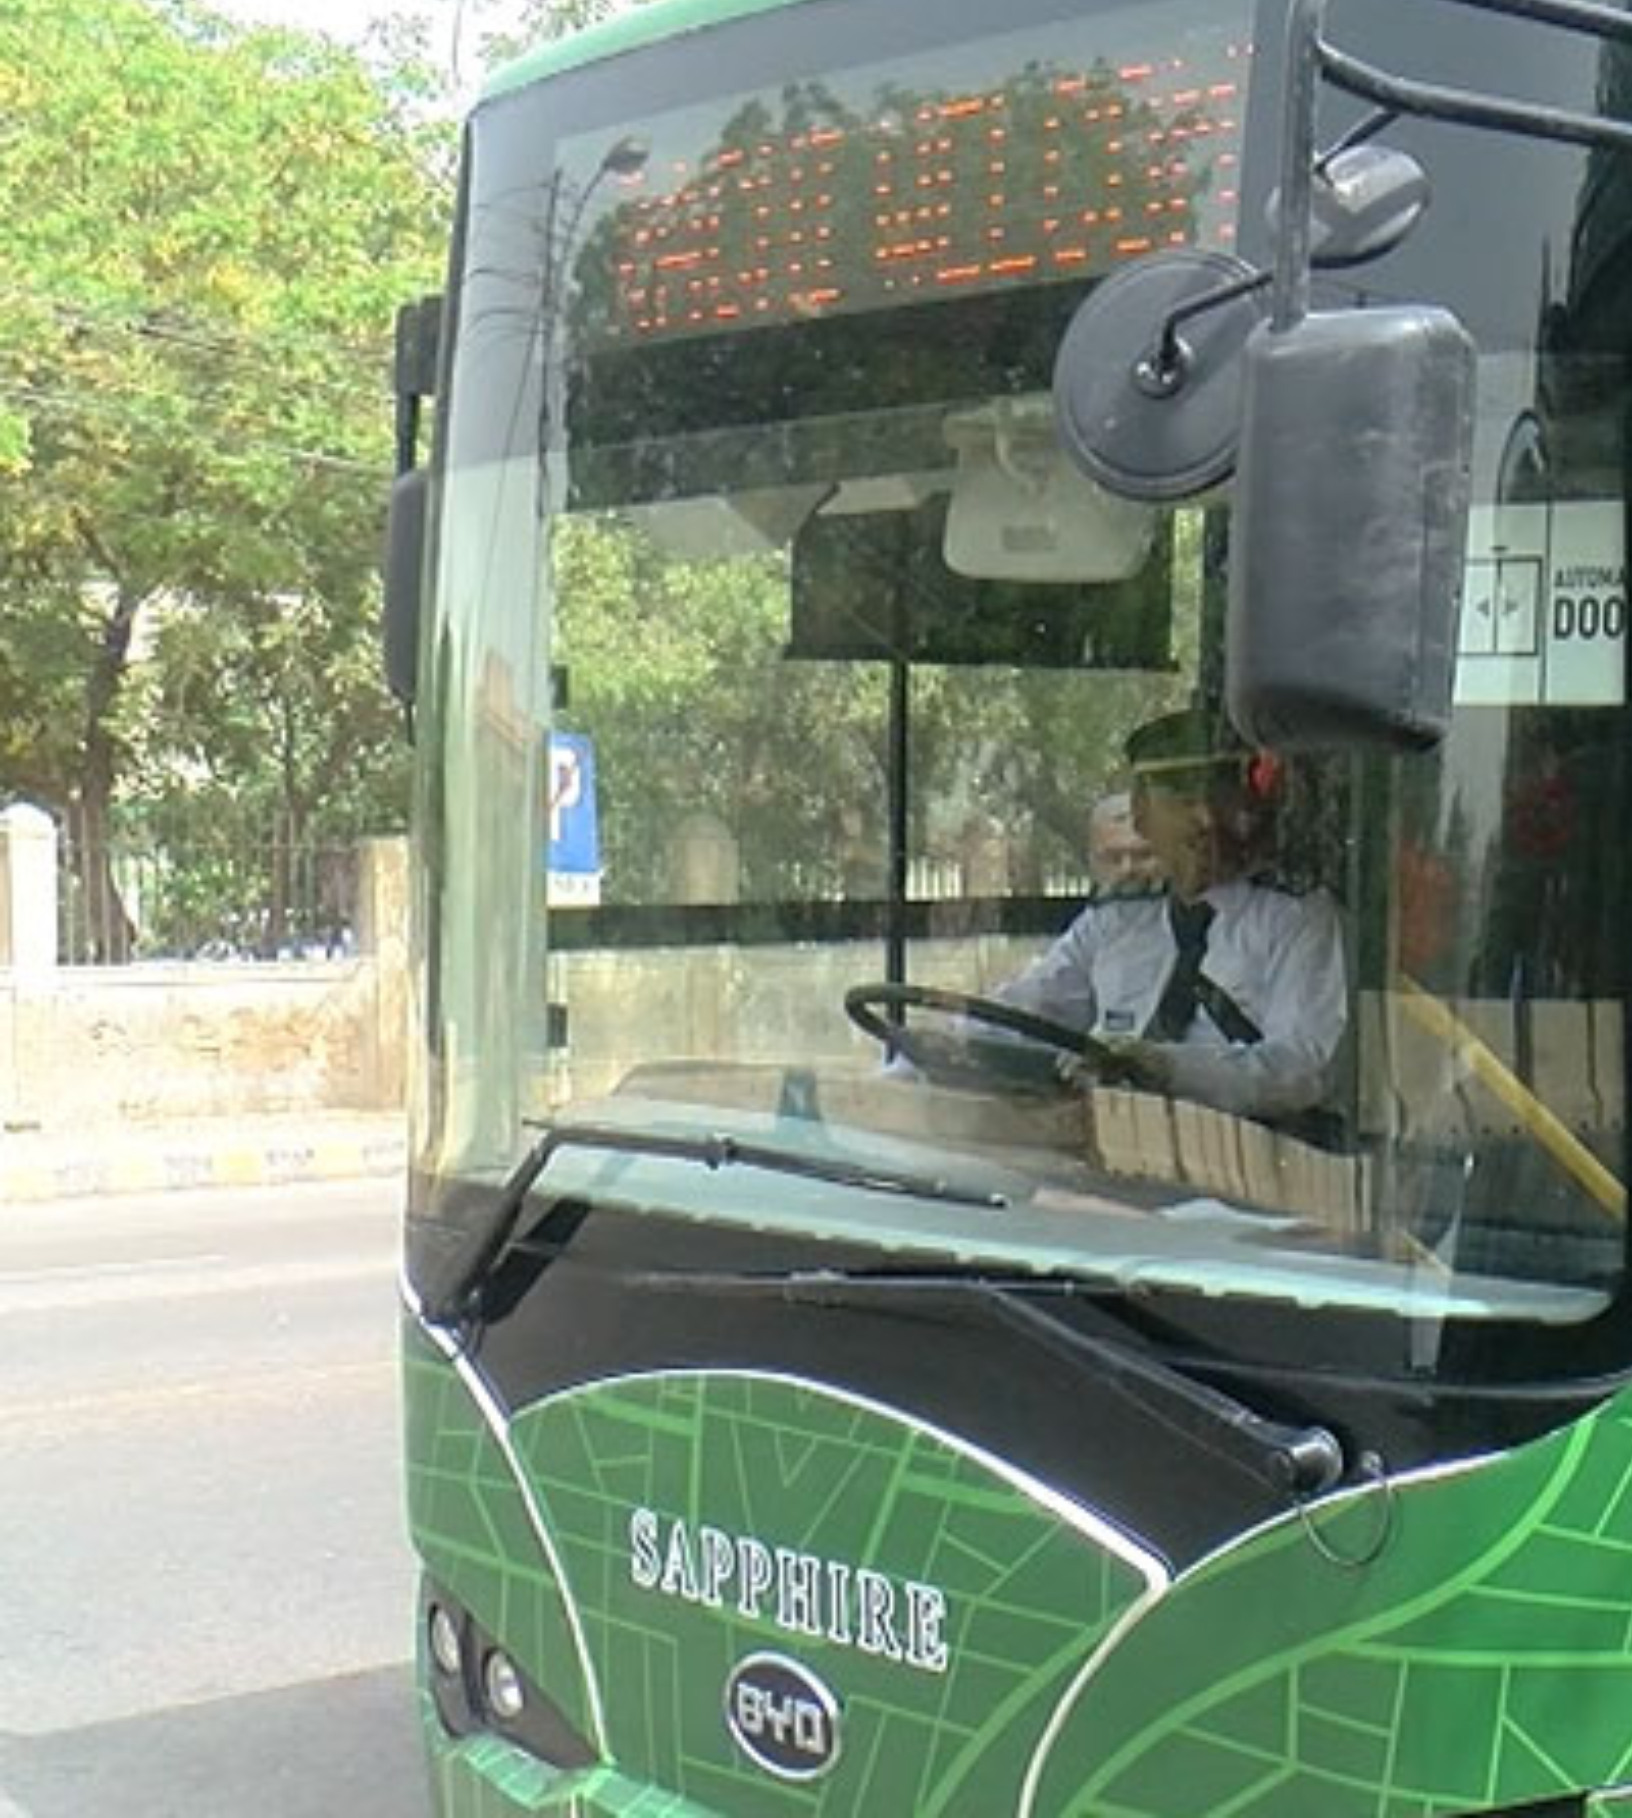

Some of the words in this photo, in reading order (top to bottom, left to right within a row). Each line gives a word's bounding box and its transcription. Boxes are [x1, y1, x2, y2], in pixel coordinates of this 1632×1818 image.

[1554, 597, 1626, 639] DOO
[630, 1507, 949, 1672] SAPPHIRE
[735, 1682, 826, 1755] BYD
